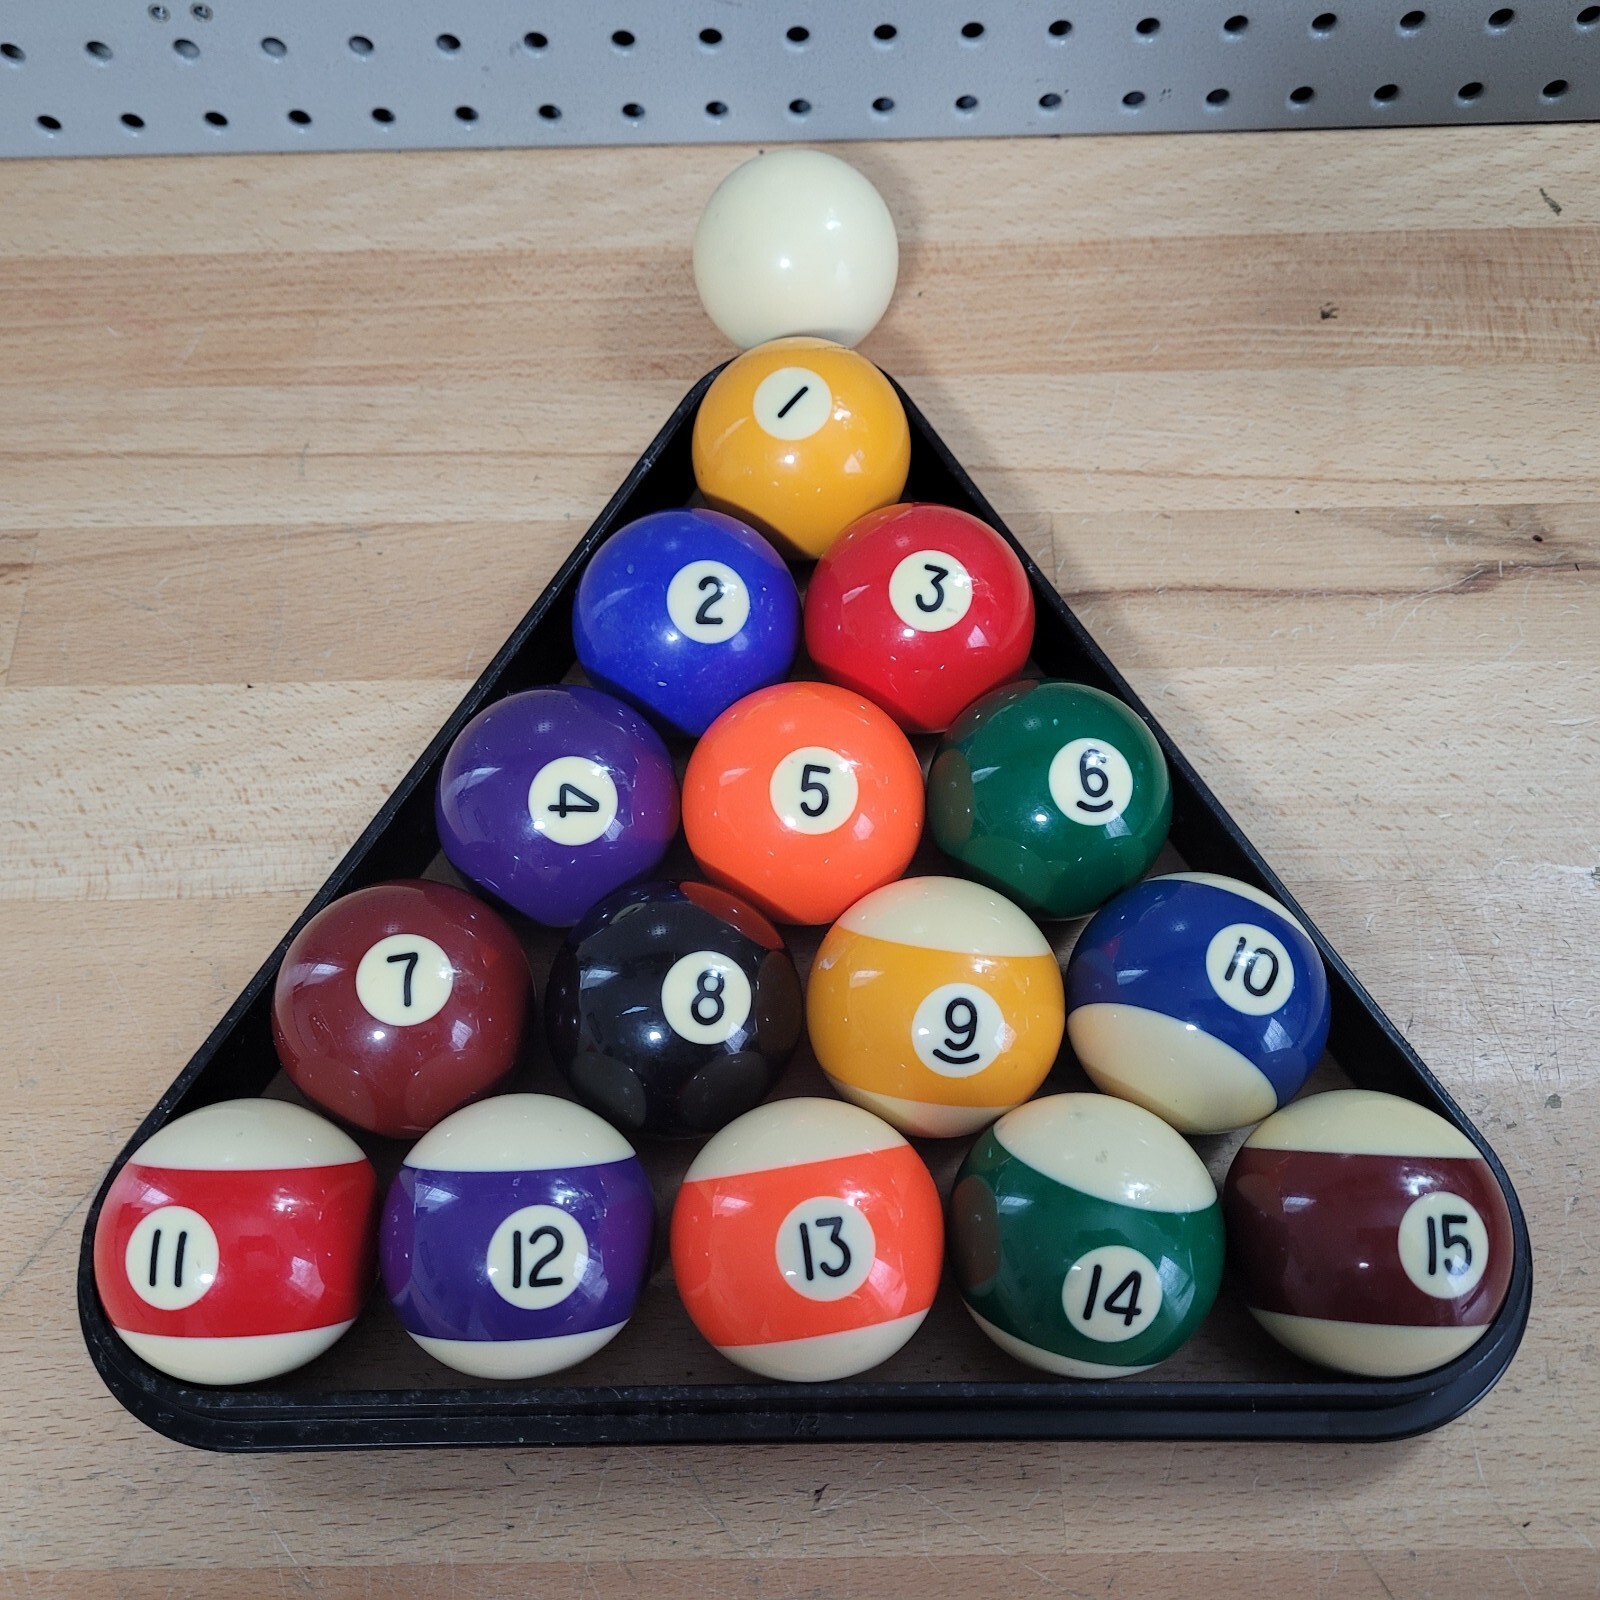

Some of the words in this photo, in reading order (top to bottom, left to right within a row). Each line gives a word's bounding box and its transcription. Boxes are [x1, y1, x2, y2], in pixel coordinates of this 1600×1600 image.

[777, 386, 809, 419] 1
[695, 575, 724, 625] 2
[915, 563, 949, 613] 3
[547, 783, 600, 819] 4
[800, 763, 831, 818] 5
[1077, 748, 1114, 813] 6
[386, 951, 419, 1008] 7
[1223, 936, 1280, 997] 10
[690, 969, 725, 1027] 8
[932, 997, 980, 1065] 9
[148, 1228, 188, 1288] 11
[512, 1225, 565, 1289] 12
[799, 1215, 852, 1282] 13
[1426, 1213, 1473, 1276] 15
[1081, 1263, 1143, 1327] 14
